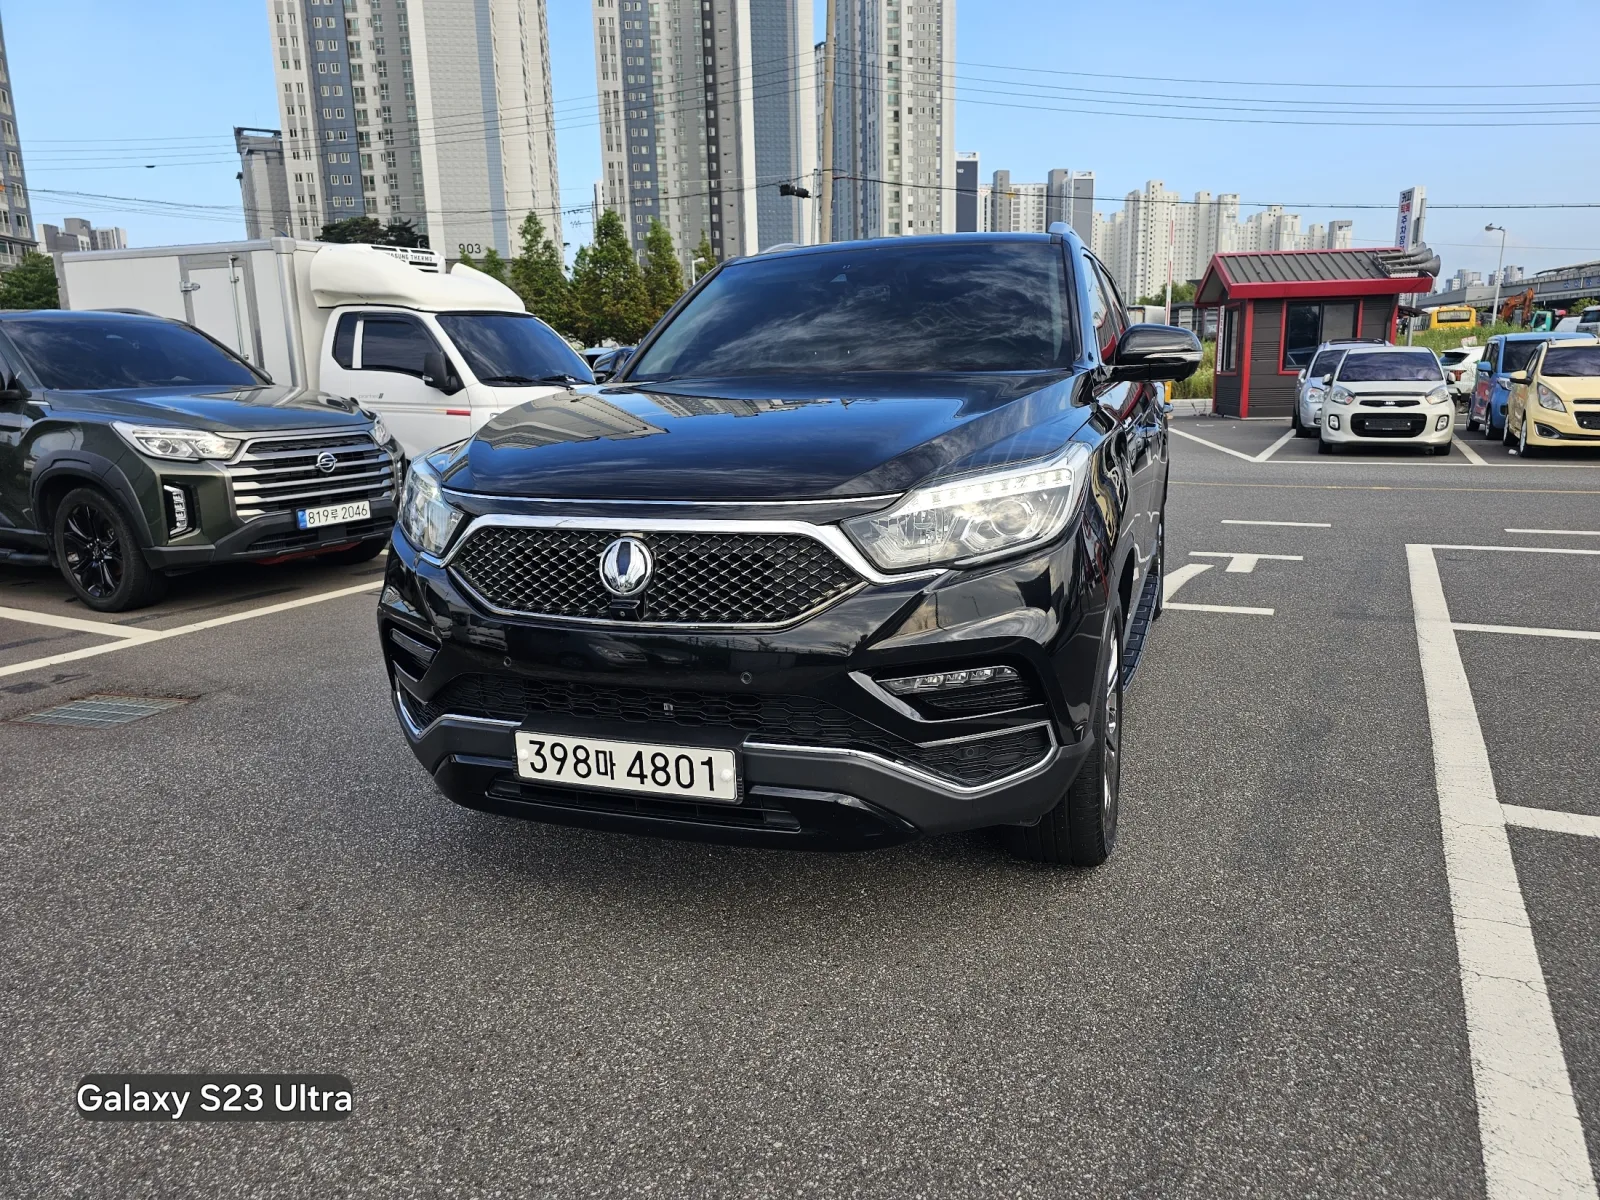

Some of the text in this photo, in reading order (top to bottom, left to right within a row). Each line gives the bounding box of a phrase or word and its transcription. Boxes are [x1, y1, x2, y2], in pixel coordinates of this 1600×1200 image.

[458, 243, 481, 254] 903
[308, 504, 368, 525] 819루 2046
[528, 739, 715, 791] 398마 4801
